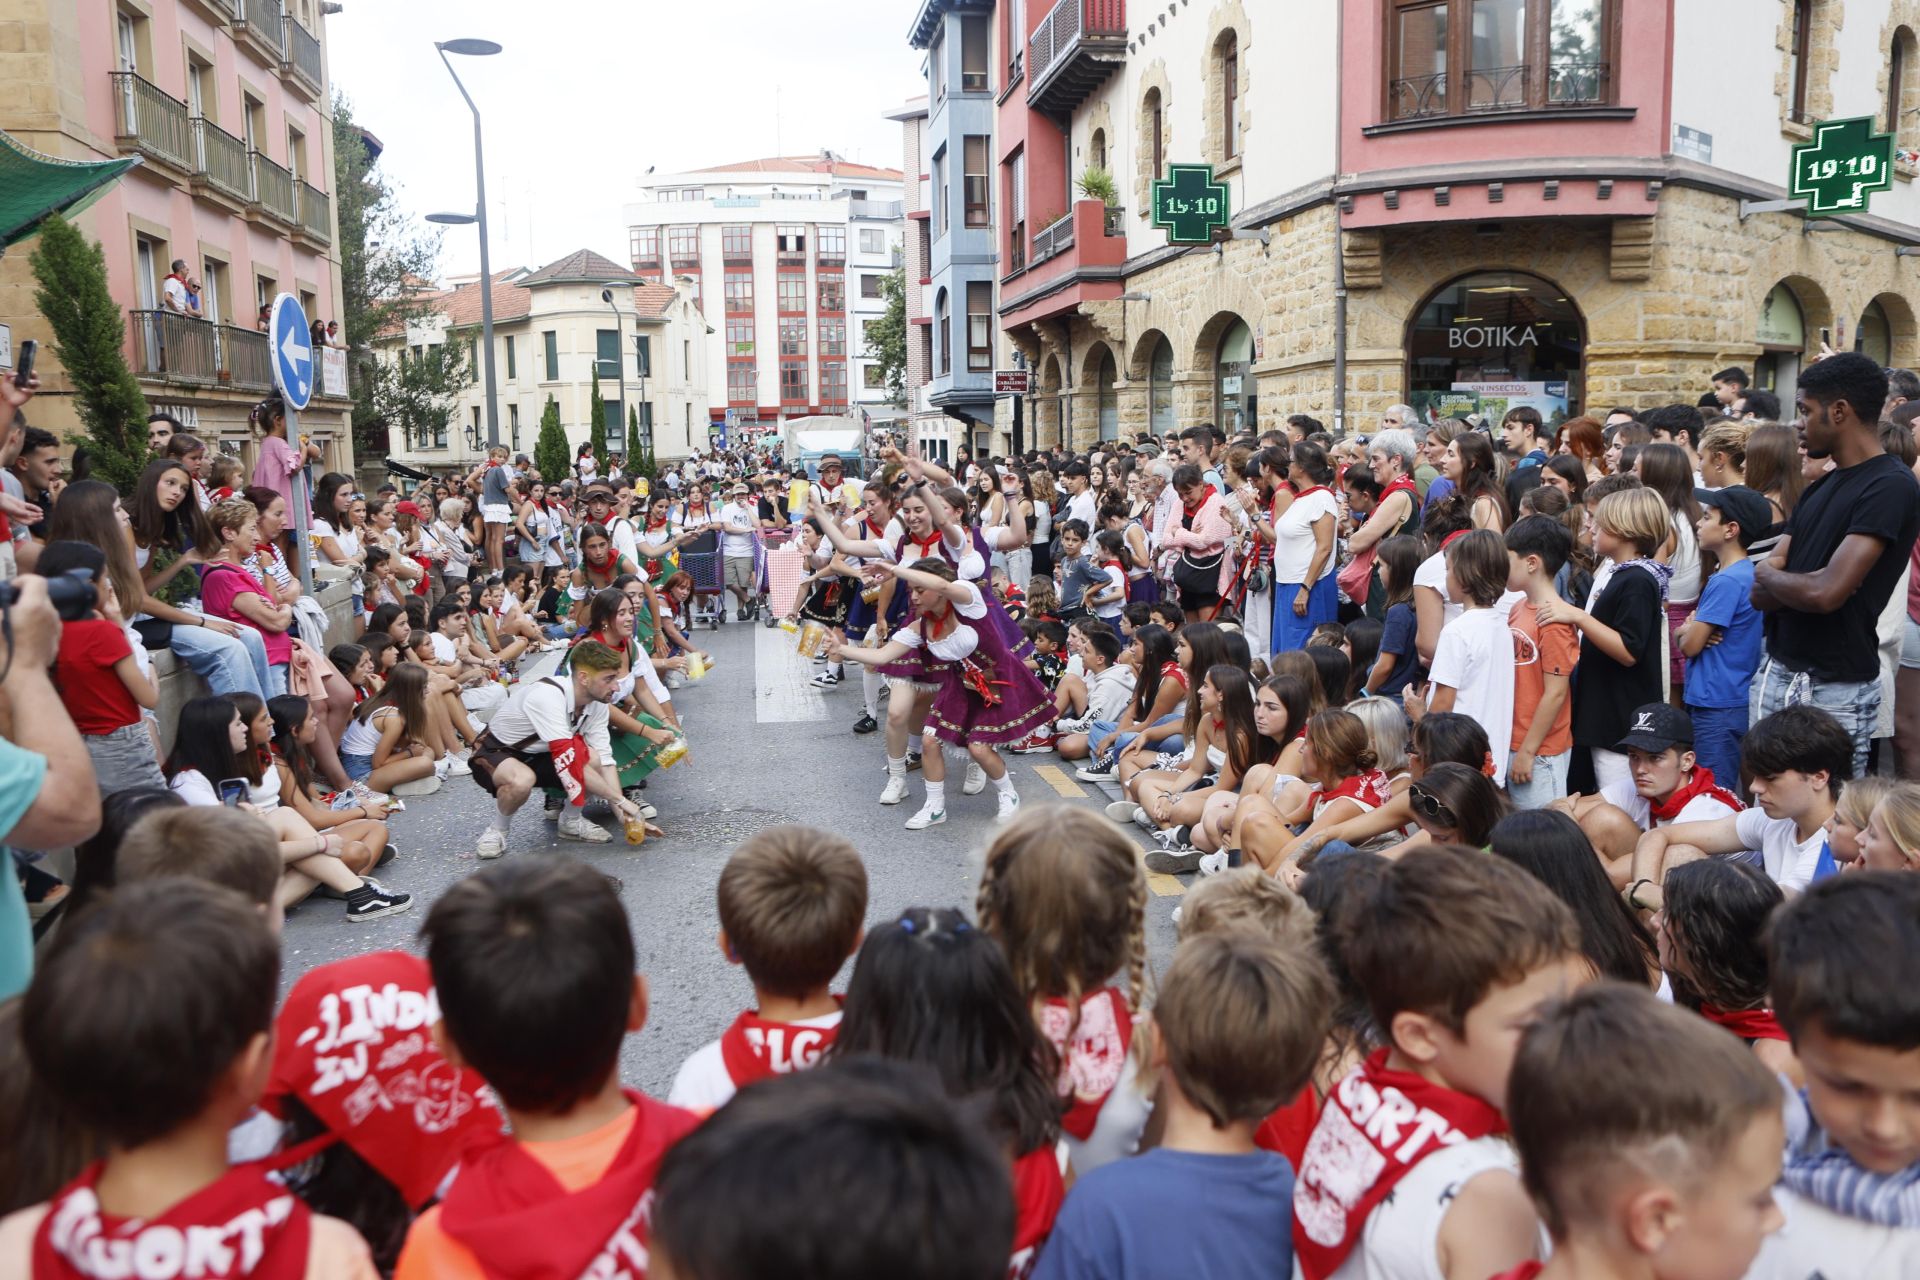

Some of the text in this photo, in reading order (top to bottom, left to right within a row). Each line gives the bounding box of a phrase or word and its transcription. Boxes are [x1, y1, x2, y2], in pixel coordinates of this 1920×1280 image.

[1807, 154, 1877, 181] 19:10
[1449, 325, 1539, 348] BOTIKA
[1486, 384, 1527, 392] INSECTOS
